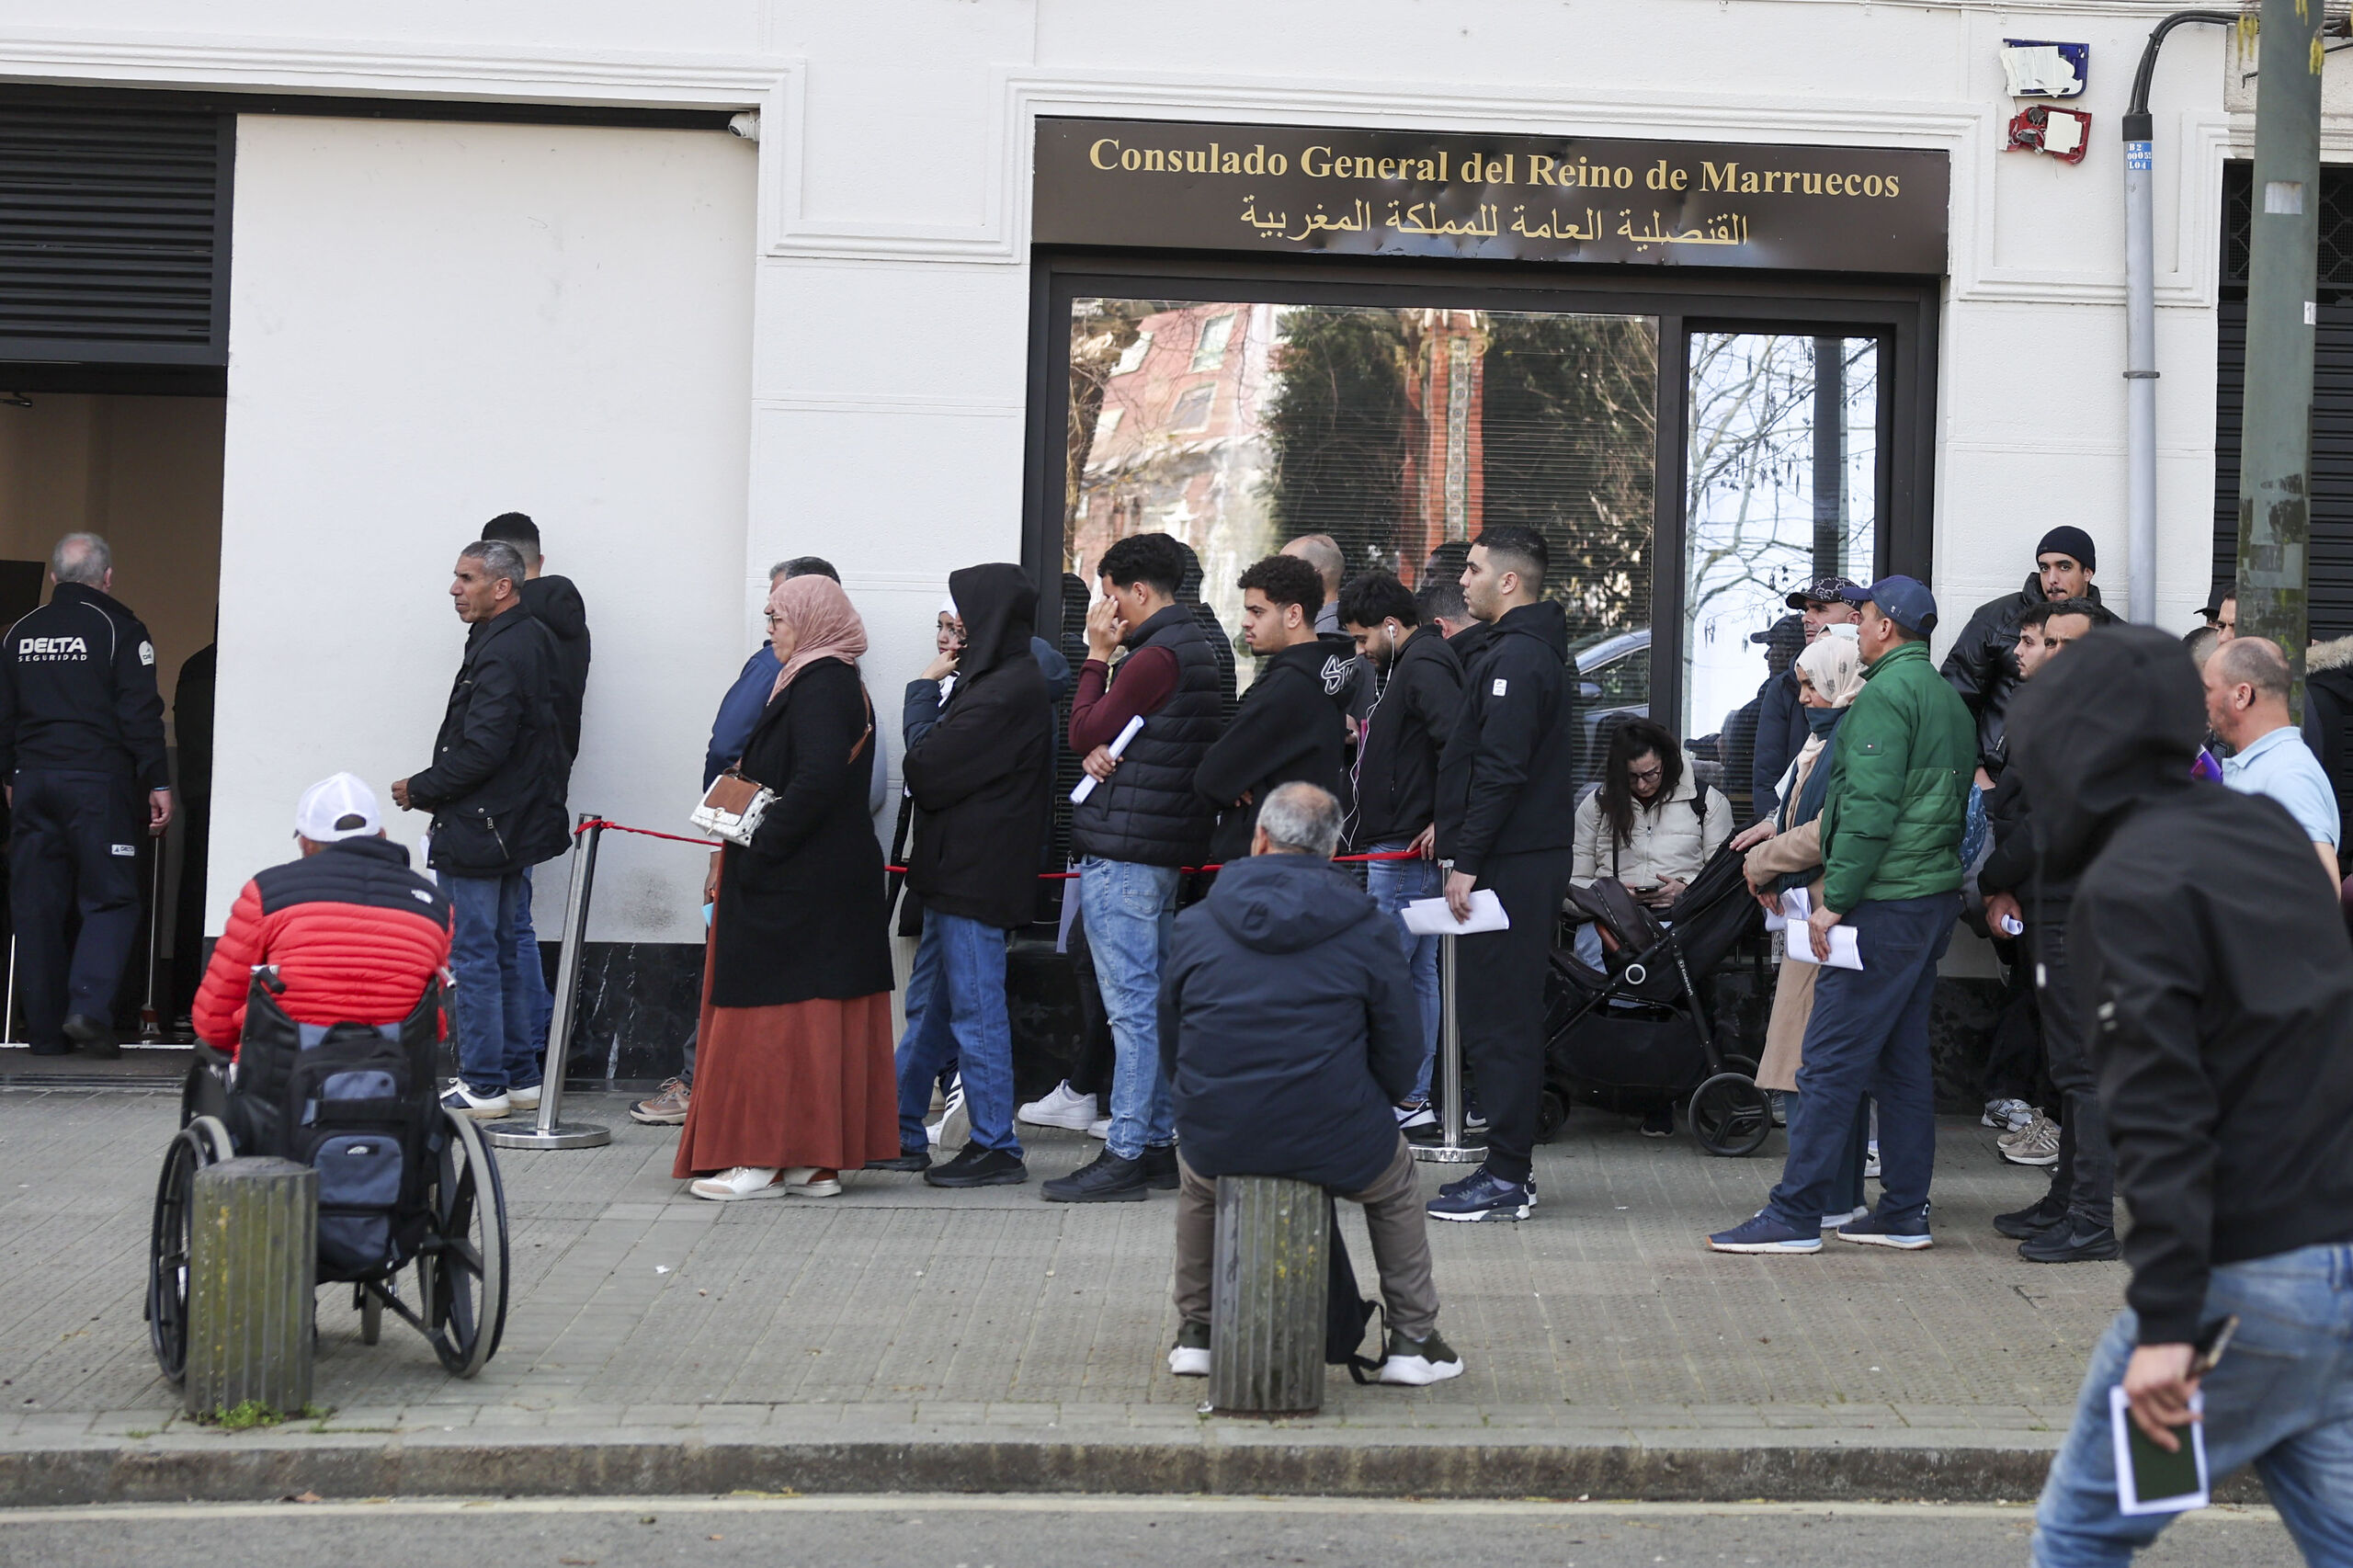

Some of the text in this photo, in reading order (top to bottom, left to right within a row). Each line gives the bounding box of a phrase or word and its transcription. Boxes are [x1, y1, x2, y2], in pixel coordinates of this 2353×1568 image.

[1089, 139, 1901, 197] Consulado General del Reino de Marruecos
[1240, 193, 1749, 252] القنصلية العامة للمملكة المغربية
[17, 654, 88, 663] SEGURIDAD
[18, 637, 87, 654] DELTA
